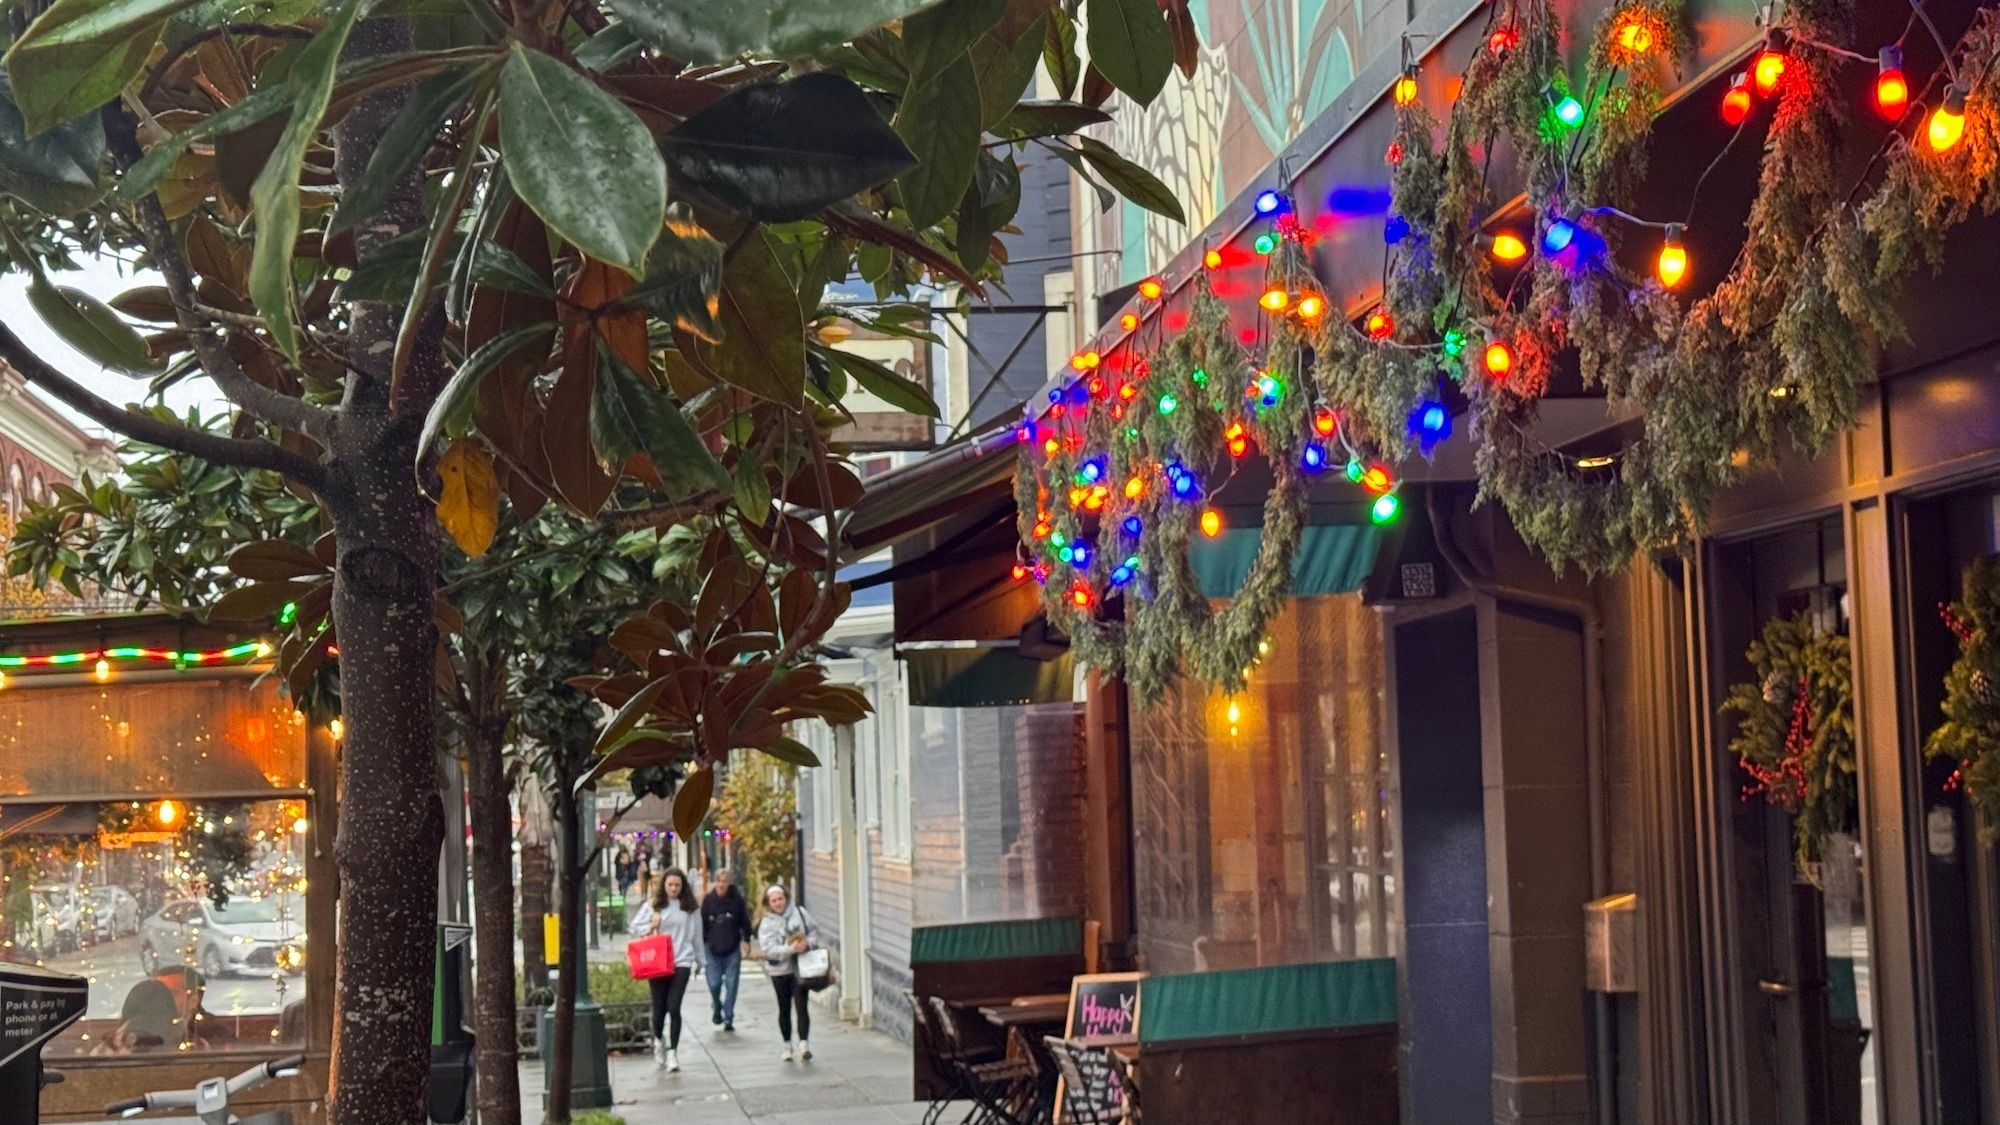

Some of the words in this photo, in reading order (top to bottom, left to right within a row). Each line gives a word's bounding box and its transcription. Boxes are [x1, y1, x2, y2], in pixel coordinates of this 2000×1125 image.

[6, 1000, 29, 1010] Park
[31, 1000, 39, 1010] &
[40, 1000, 56, 1010] pay
[56, 998, 66, 1009] by
[5, 1014, 37, 1025] phone
[38, 1013, 48, 1021] or
[49, 1011, 58, 1020] at
[5, 1027, 34, 1037] meter
